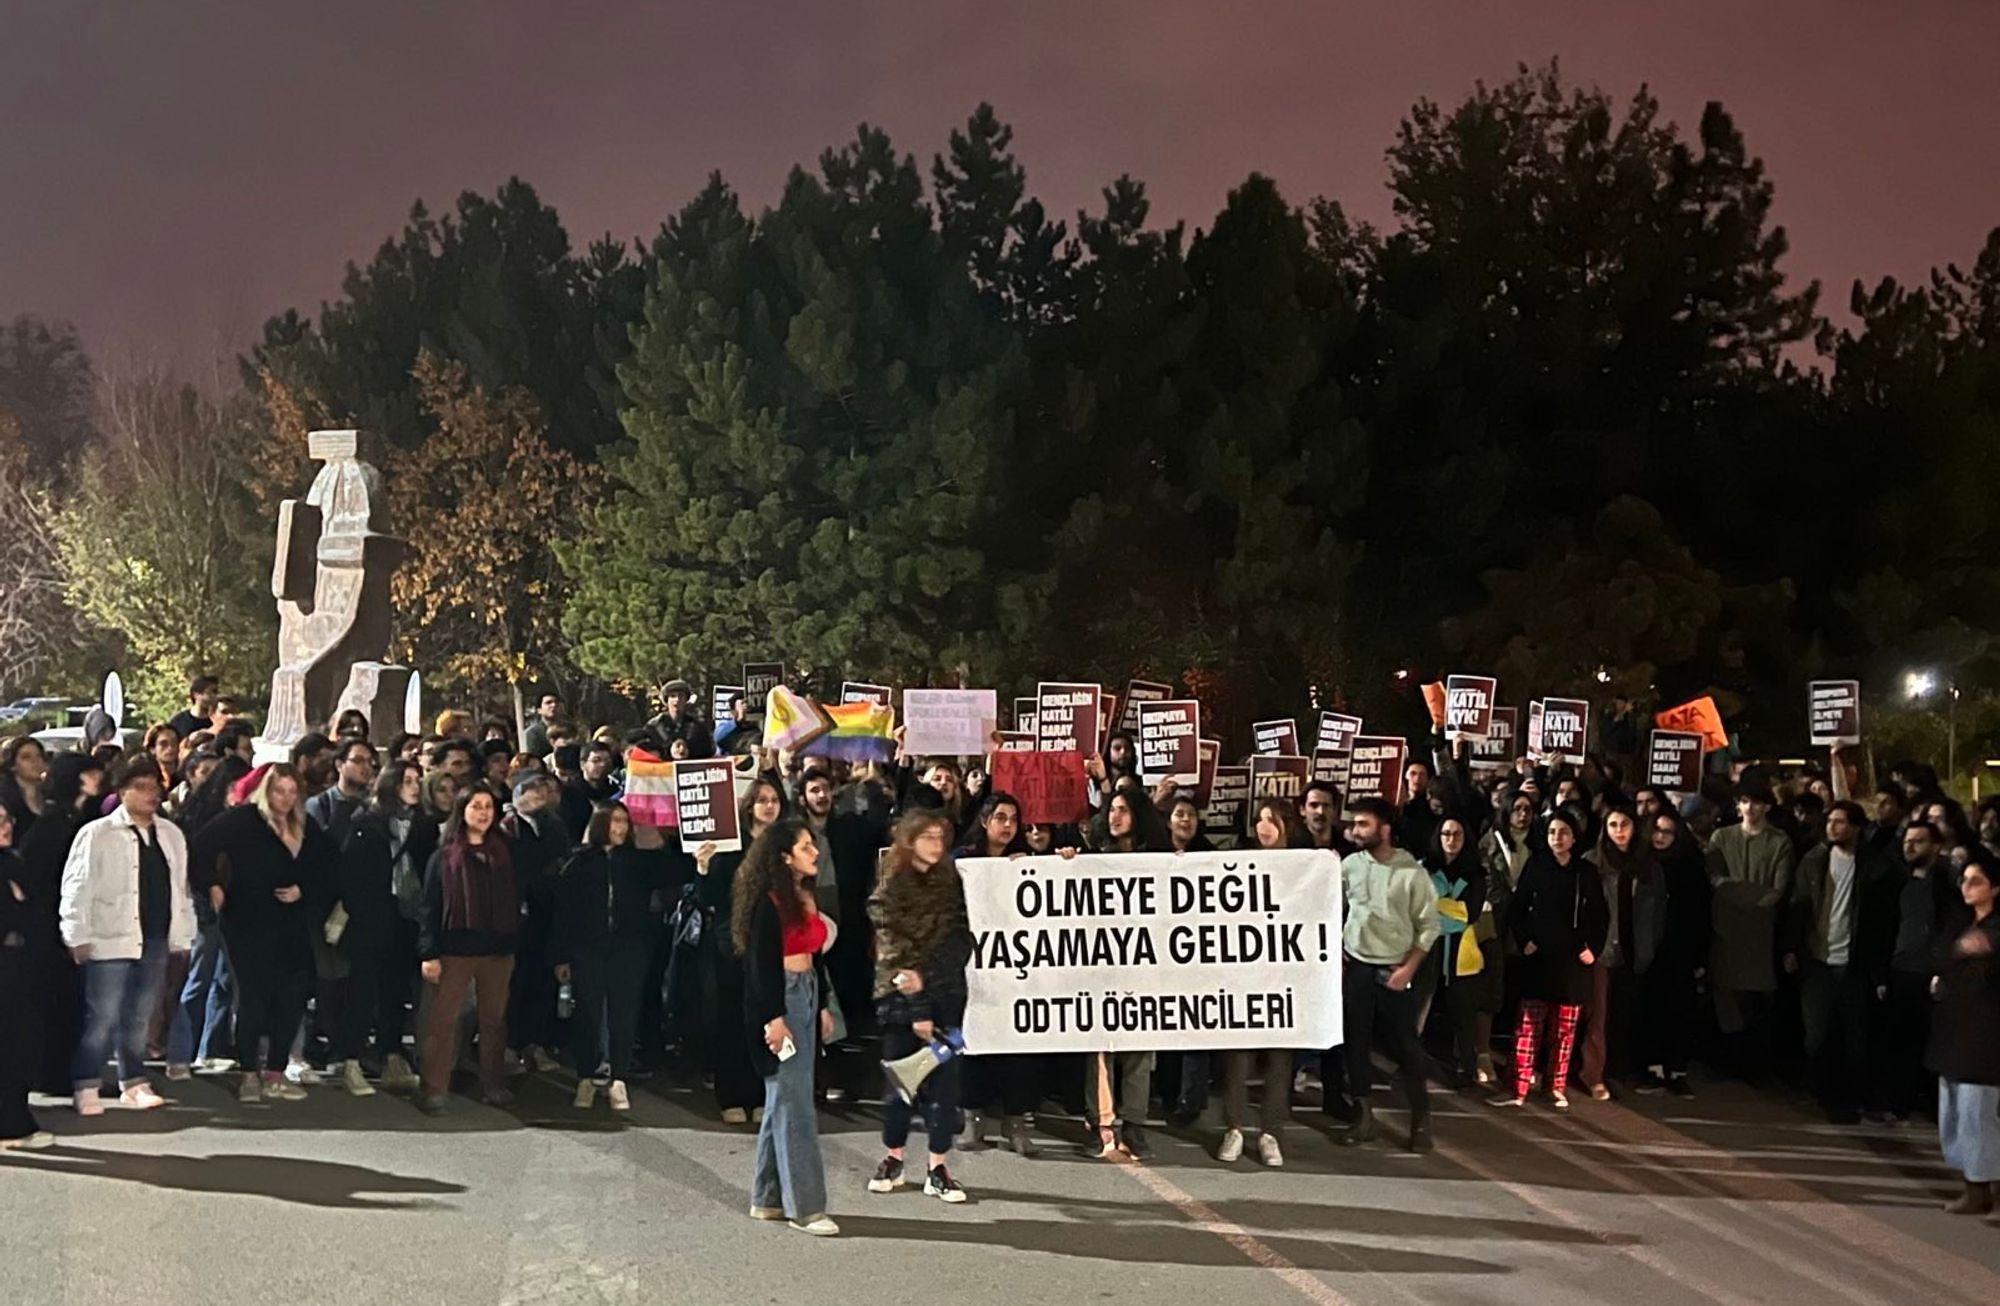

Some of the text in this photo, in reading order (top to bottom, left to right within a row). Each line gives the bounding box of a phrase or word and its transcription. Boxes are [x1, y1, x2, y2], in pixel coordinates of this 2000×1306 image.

[1449, 689, 1489, 709] KATİL
[1041, 707, 1074, 722] KATİLİ
[1448, 709, 1478, 725] KYK!
[1041, 724, 1073, 737] SARAY
[1545, 714, 1583, 732] KATİL
[1544, 732, 1574, 748] KYK!
[1350, 777, 1380, 790] SARAY
[679, 785, 710, 802] KATİLİ
[680, 803, 710, 819] SARAY
[1016, 862, 1281, 917] ÖLMEYE DEĞİL
[970, 926, 1157, 979] YAŞAMAYA
[1168, 912, 1305, 964] GELDİK
[1014, 987, 1294, 1032] ODTÜ ÖĞRENCİLERİ
